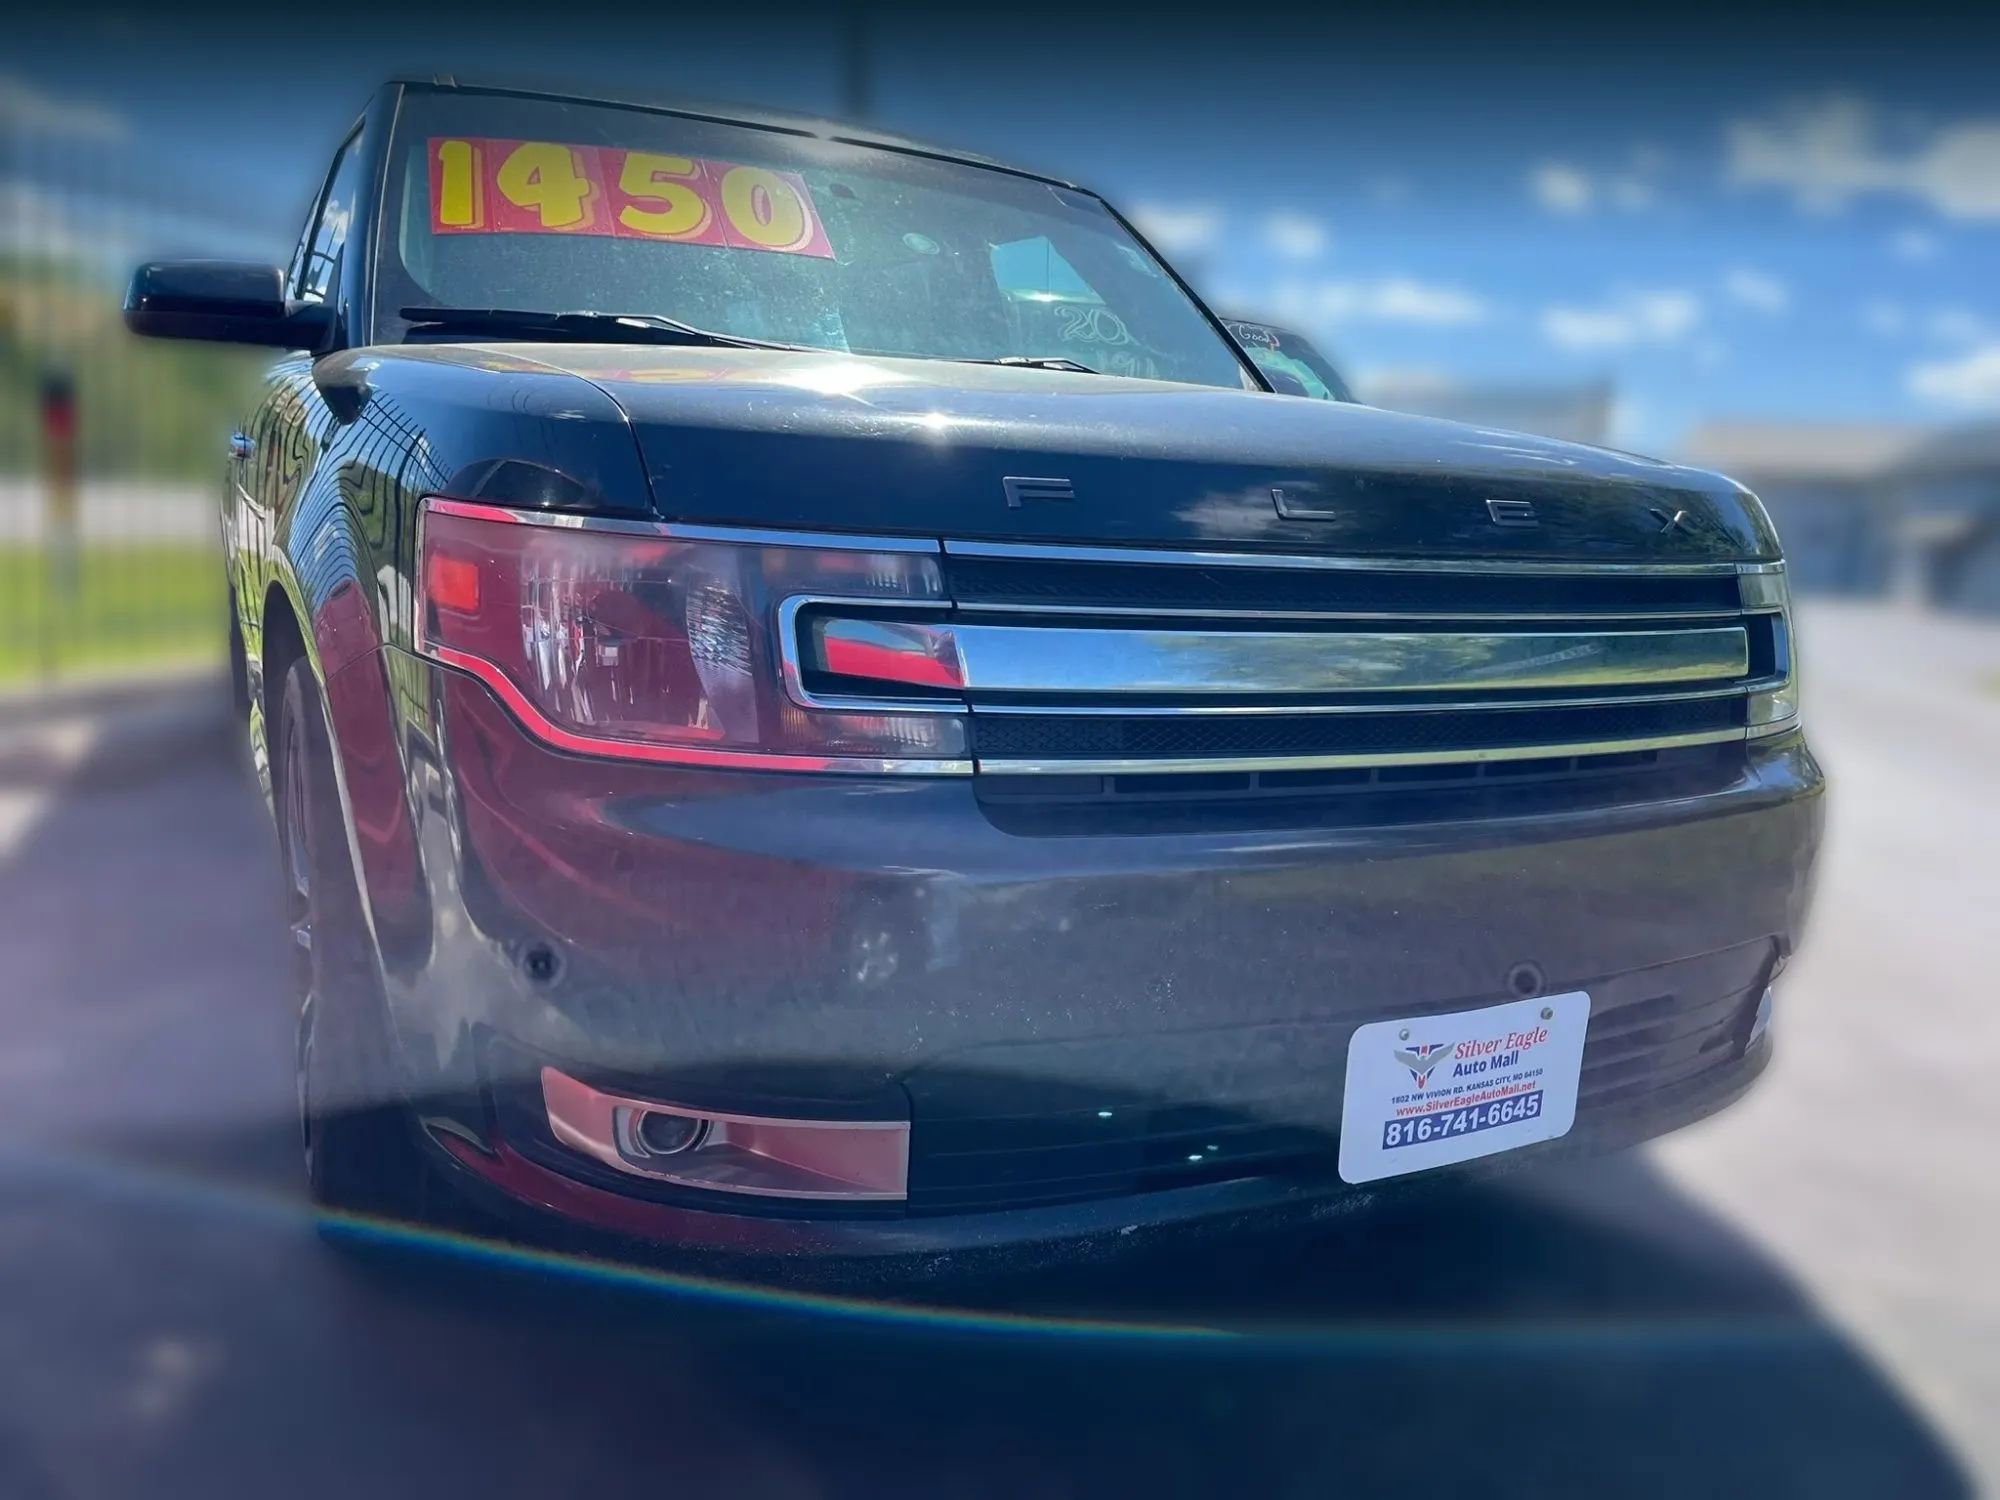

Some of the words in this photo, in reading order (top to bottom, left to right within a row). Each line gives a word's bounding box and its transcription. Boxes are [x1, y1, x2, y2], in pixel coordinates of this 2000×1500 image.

[439, 140, 814, 252] 1450
[1002, 475, 1694, 536] FLEX
[1455, 1039, 1502, 1059] Silver
[1505, 1027, 1548, 1050] Eagle
[1453, 1060, 1487, 1077] Auto
[1490, 1050, 1519, 1069] Mall
[1396, 1081, 1536, 1117] www.SilverEagleAutoMall.net
[1411, 1093, 1425, 1101] NW
[1425, 1087, 1451, 1099] VIVION
[1466, 1078, 1494, 1092] KANSAS
[1495, 1075, 1511, 1086] CITY,
[1512, 1073, 1523, 1081] MO
[1386, 1094, 1540, 1147] 816-741-6645
